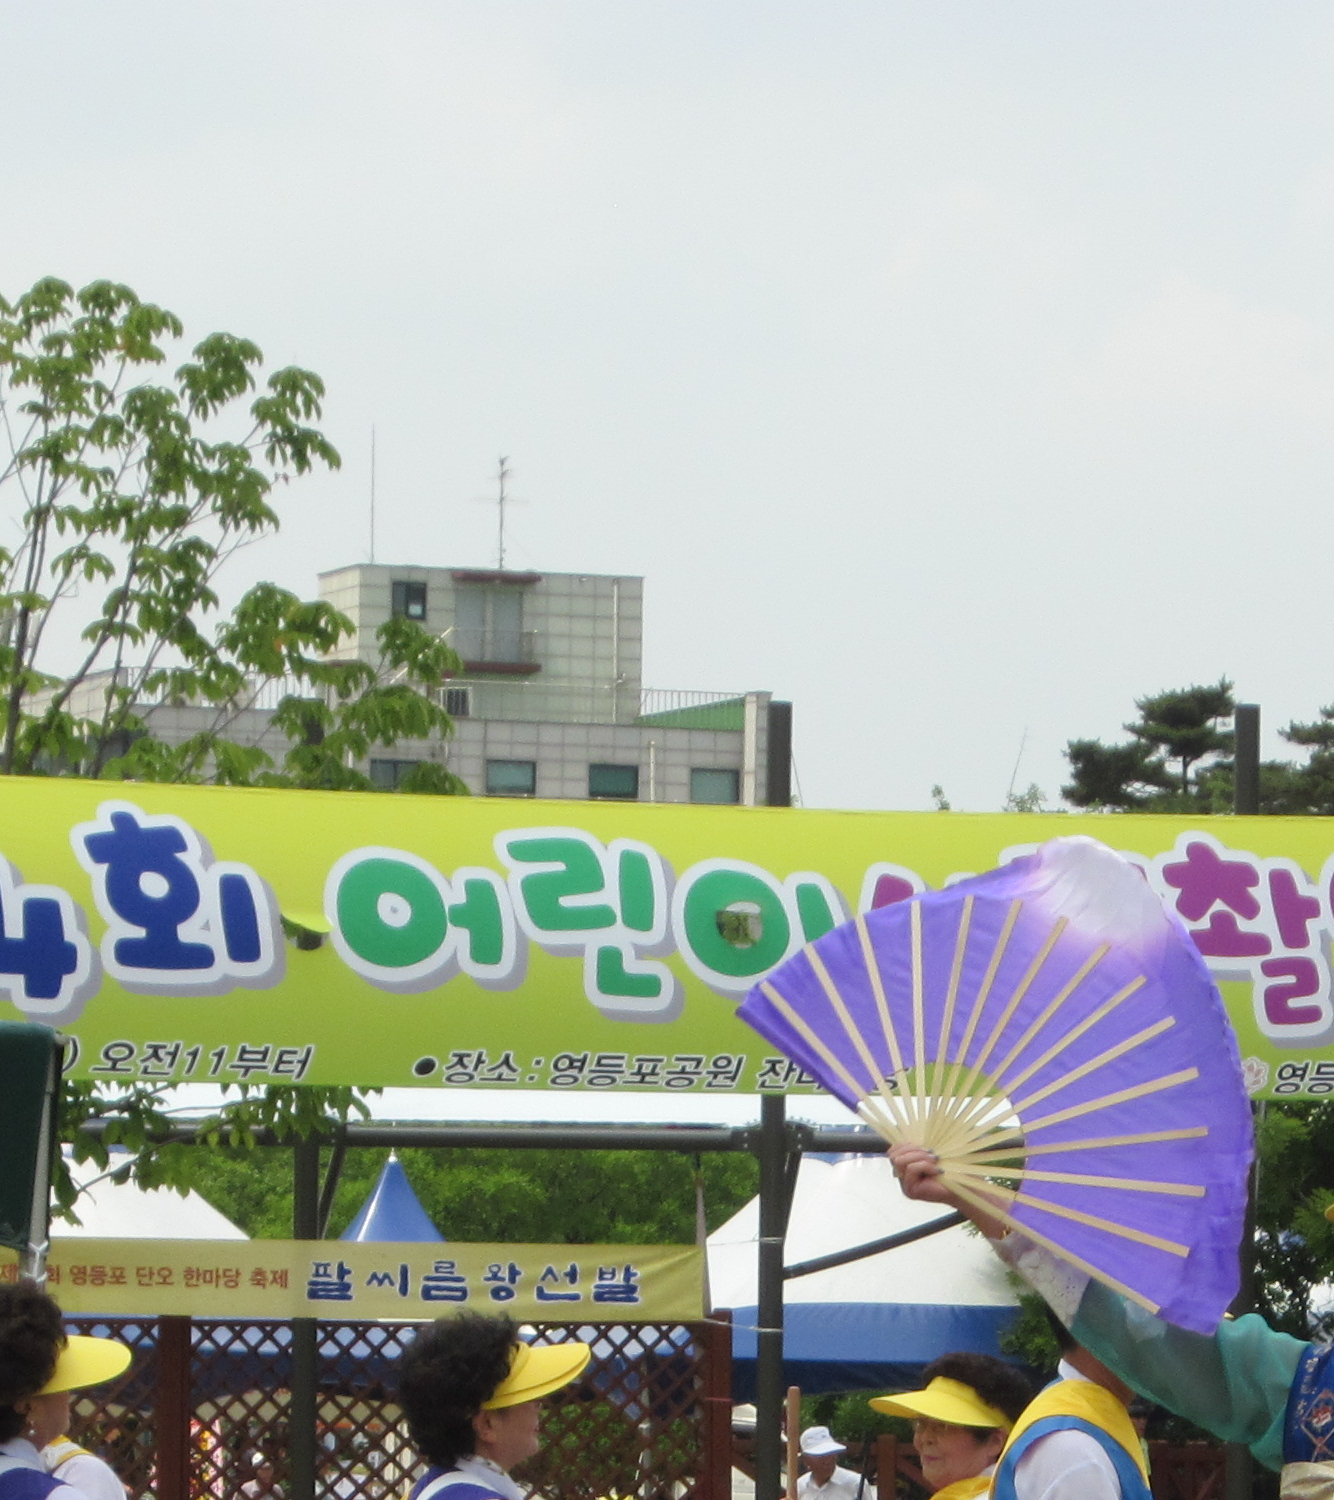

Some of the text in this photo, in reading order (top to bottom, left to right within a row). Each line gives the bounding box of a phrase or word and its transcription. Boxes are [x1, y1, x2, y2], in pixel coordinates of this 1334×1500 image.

[69, 1264, 127, 1285] 영등포
[136, 1266, 174, 1287] 단오
[183, 1266, 241, 1288] 한마당
[250, 1267, 289, 1288] 축제
